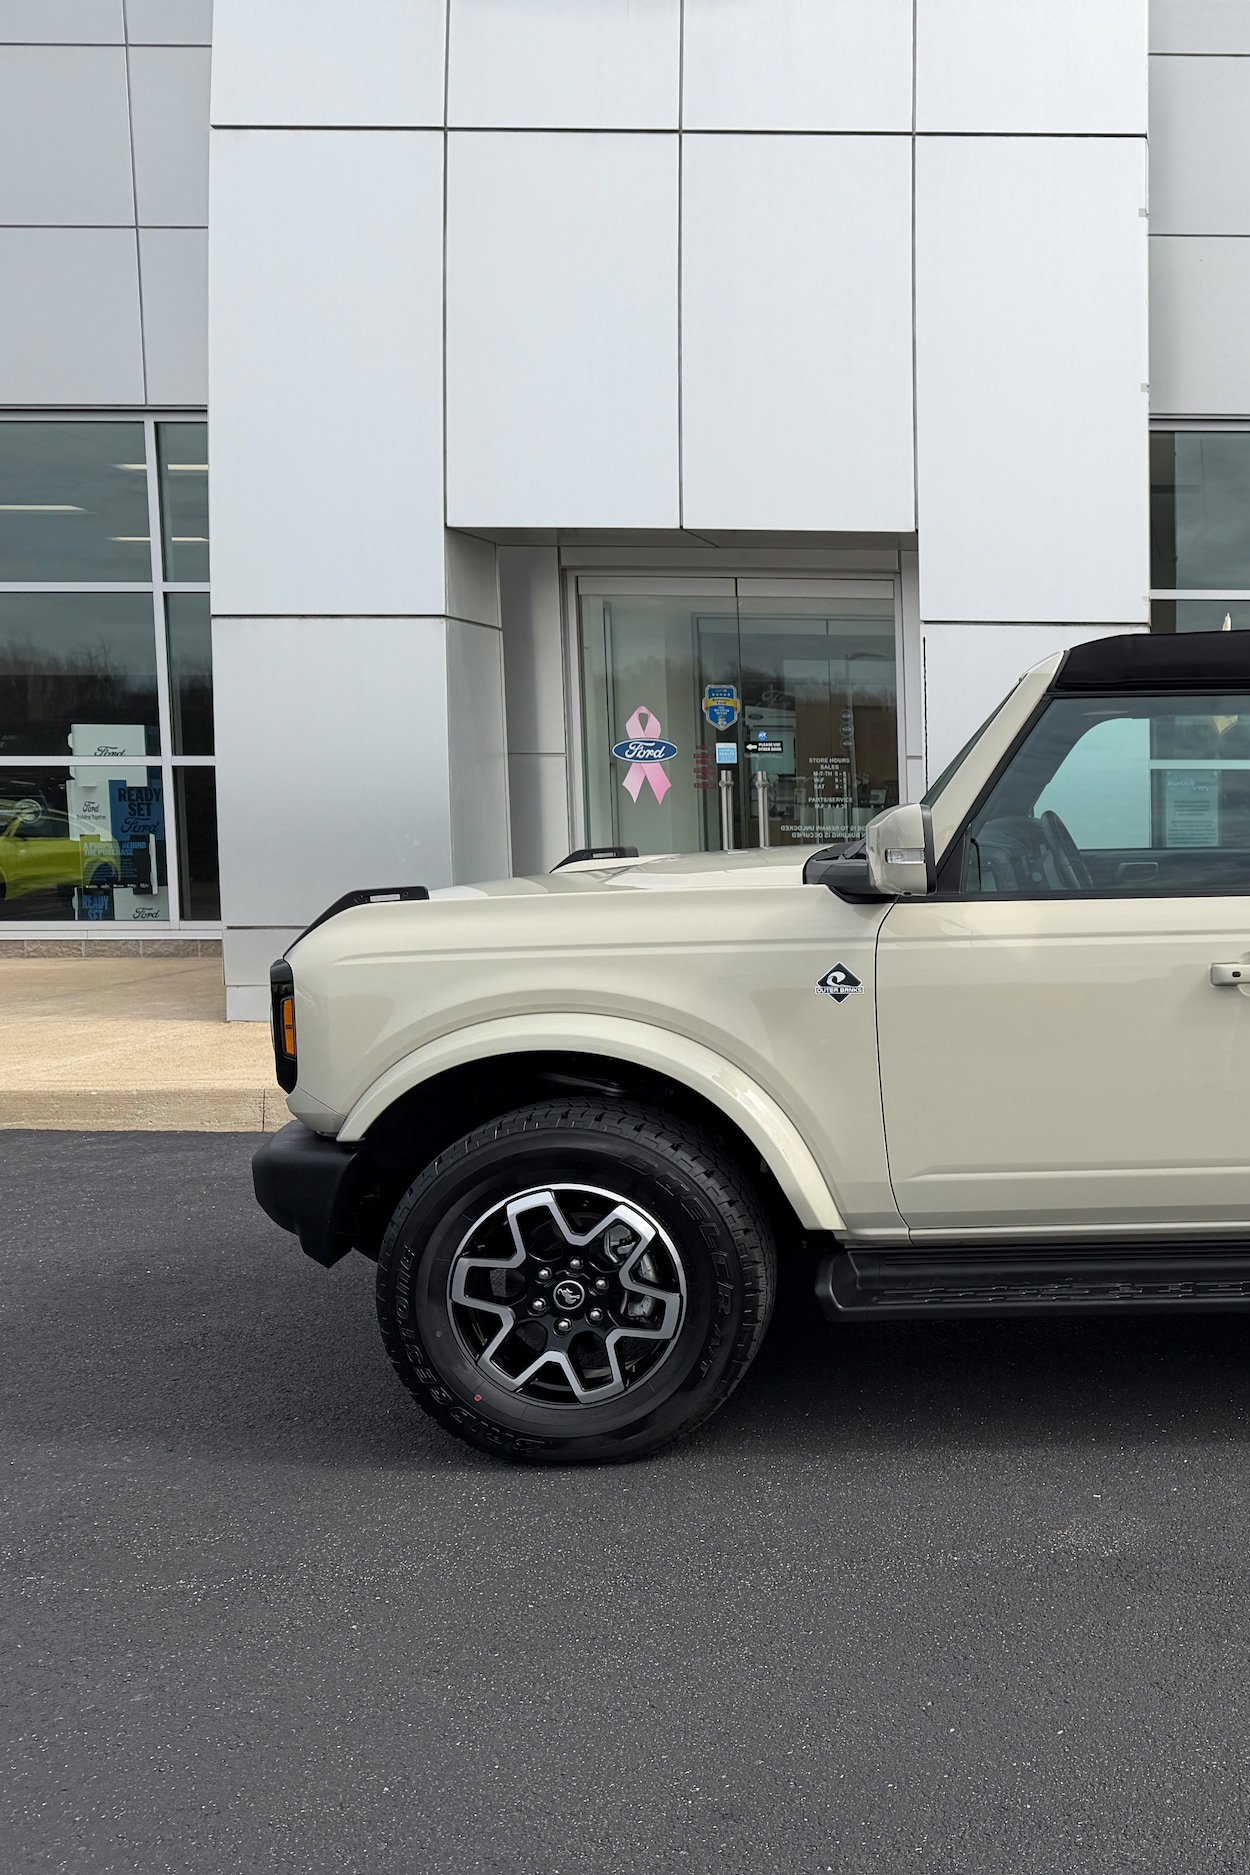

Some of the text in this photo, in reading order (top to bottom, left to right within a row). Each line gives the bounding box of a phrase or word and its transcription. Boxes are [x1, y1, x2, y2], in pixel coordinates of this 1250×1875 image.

[94, 745, 126, 757] Ford
[625, 741, 665, 759] Ford
[117, 788, 161, 802] READY
[82, 801, 100, 813] Ford
[127, 803, 152, 816] SET
[121, 817, 160, 833] Ford
[82, 895, 109, 910] READY
[133, 907, 160, 919] Ford
[394, 1244, 546, 1455] BRIDGESTONE
